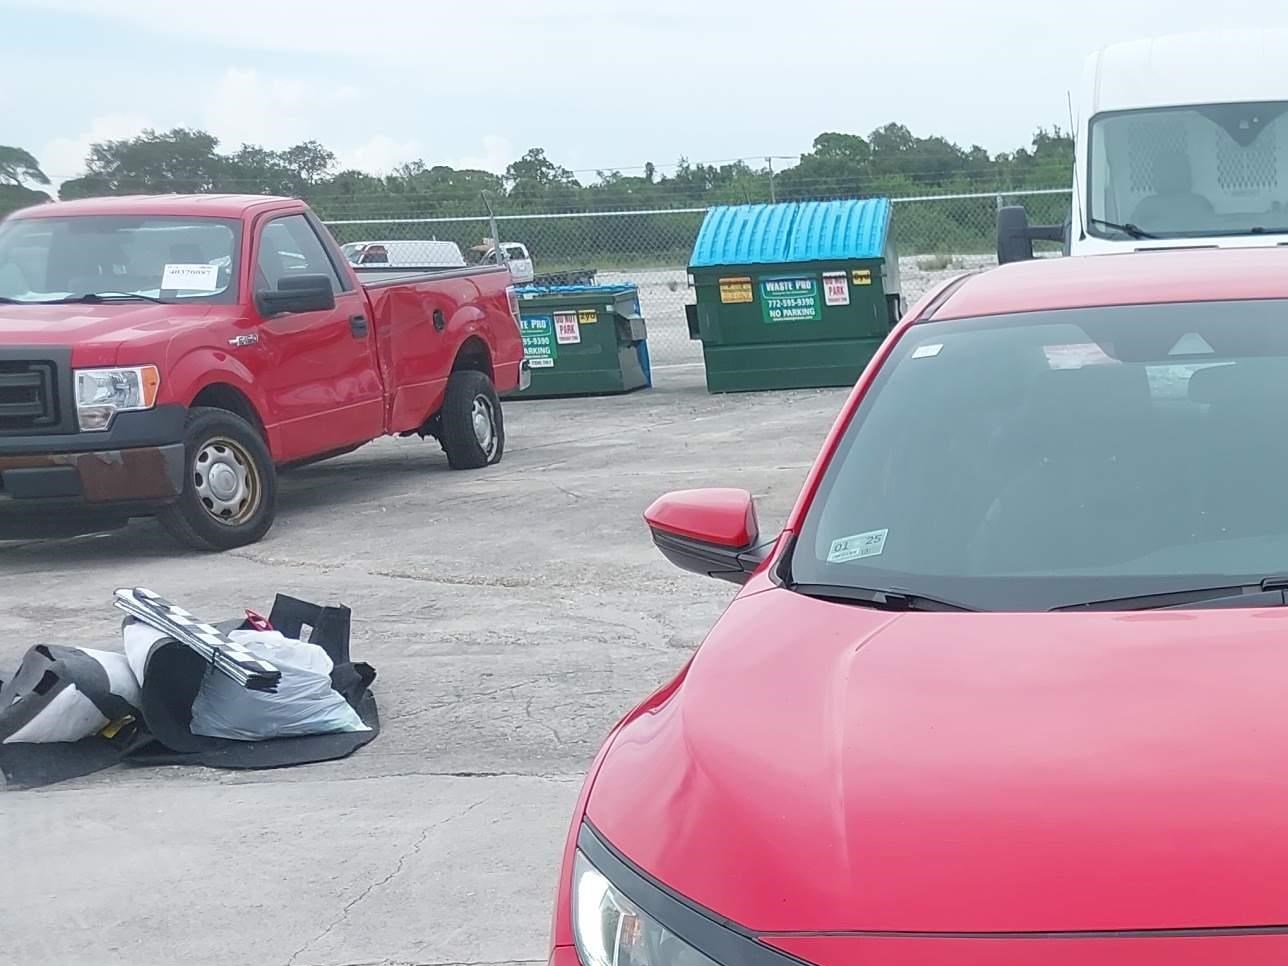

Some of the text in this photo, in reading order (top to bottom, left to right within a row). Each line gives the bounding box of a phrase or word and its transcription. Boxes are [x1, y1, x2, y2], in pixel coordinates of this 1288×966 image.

[765, 280, 793, 291] WASTE
[795, 279, 812, 290] PRO
[828, 286, 845, 297] PARK
[768, 298, 815, 308] 772-595-9390
[769, 309, 782, 318] NO
[783, 308, 816, 317] PARKING
[531, 319, 547, 329] PRO
[559, 324, 576, 334] PARK
[524, 346, 551, 355] ARKING
